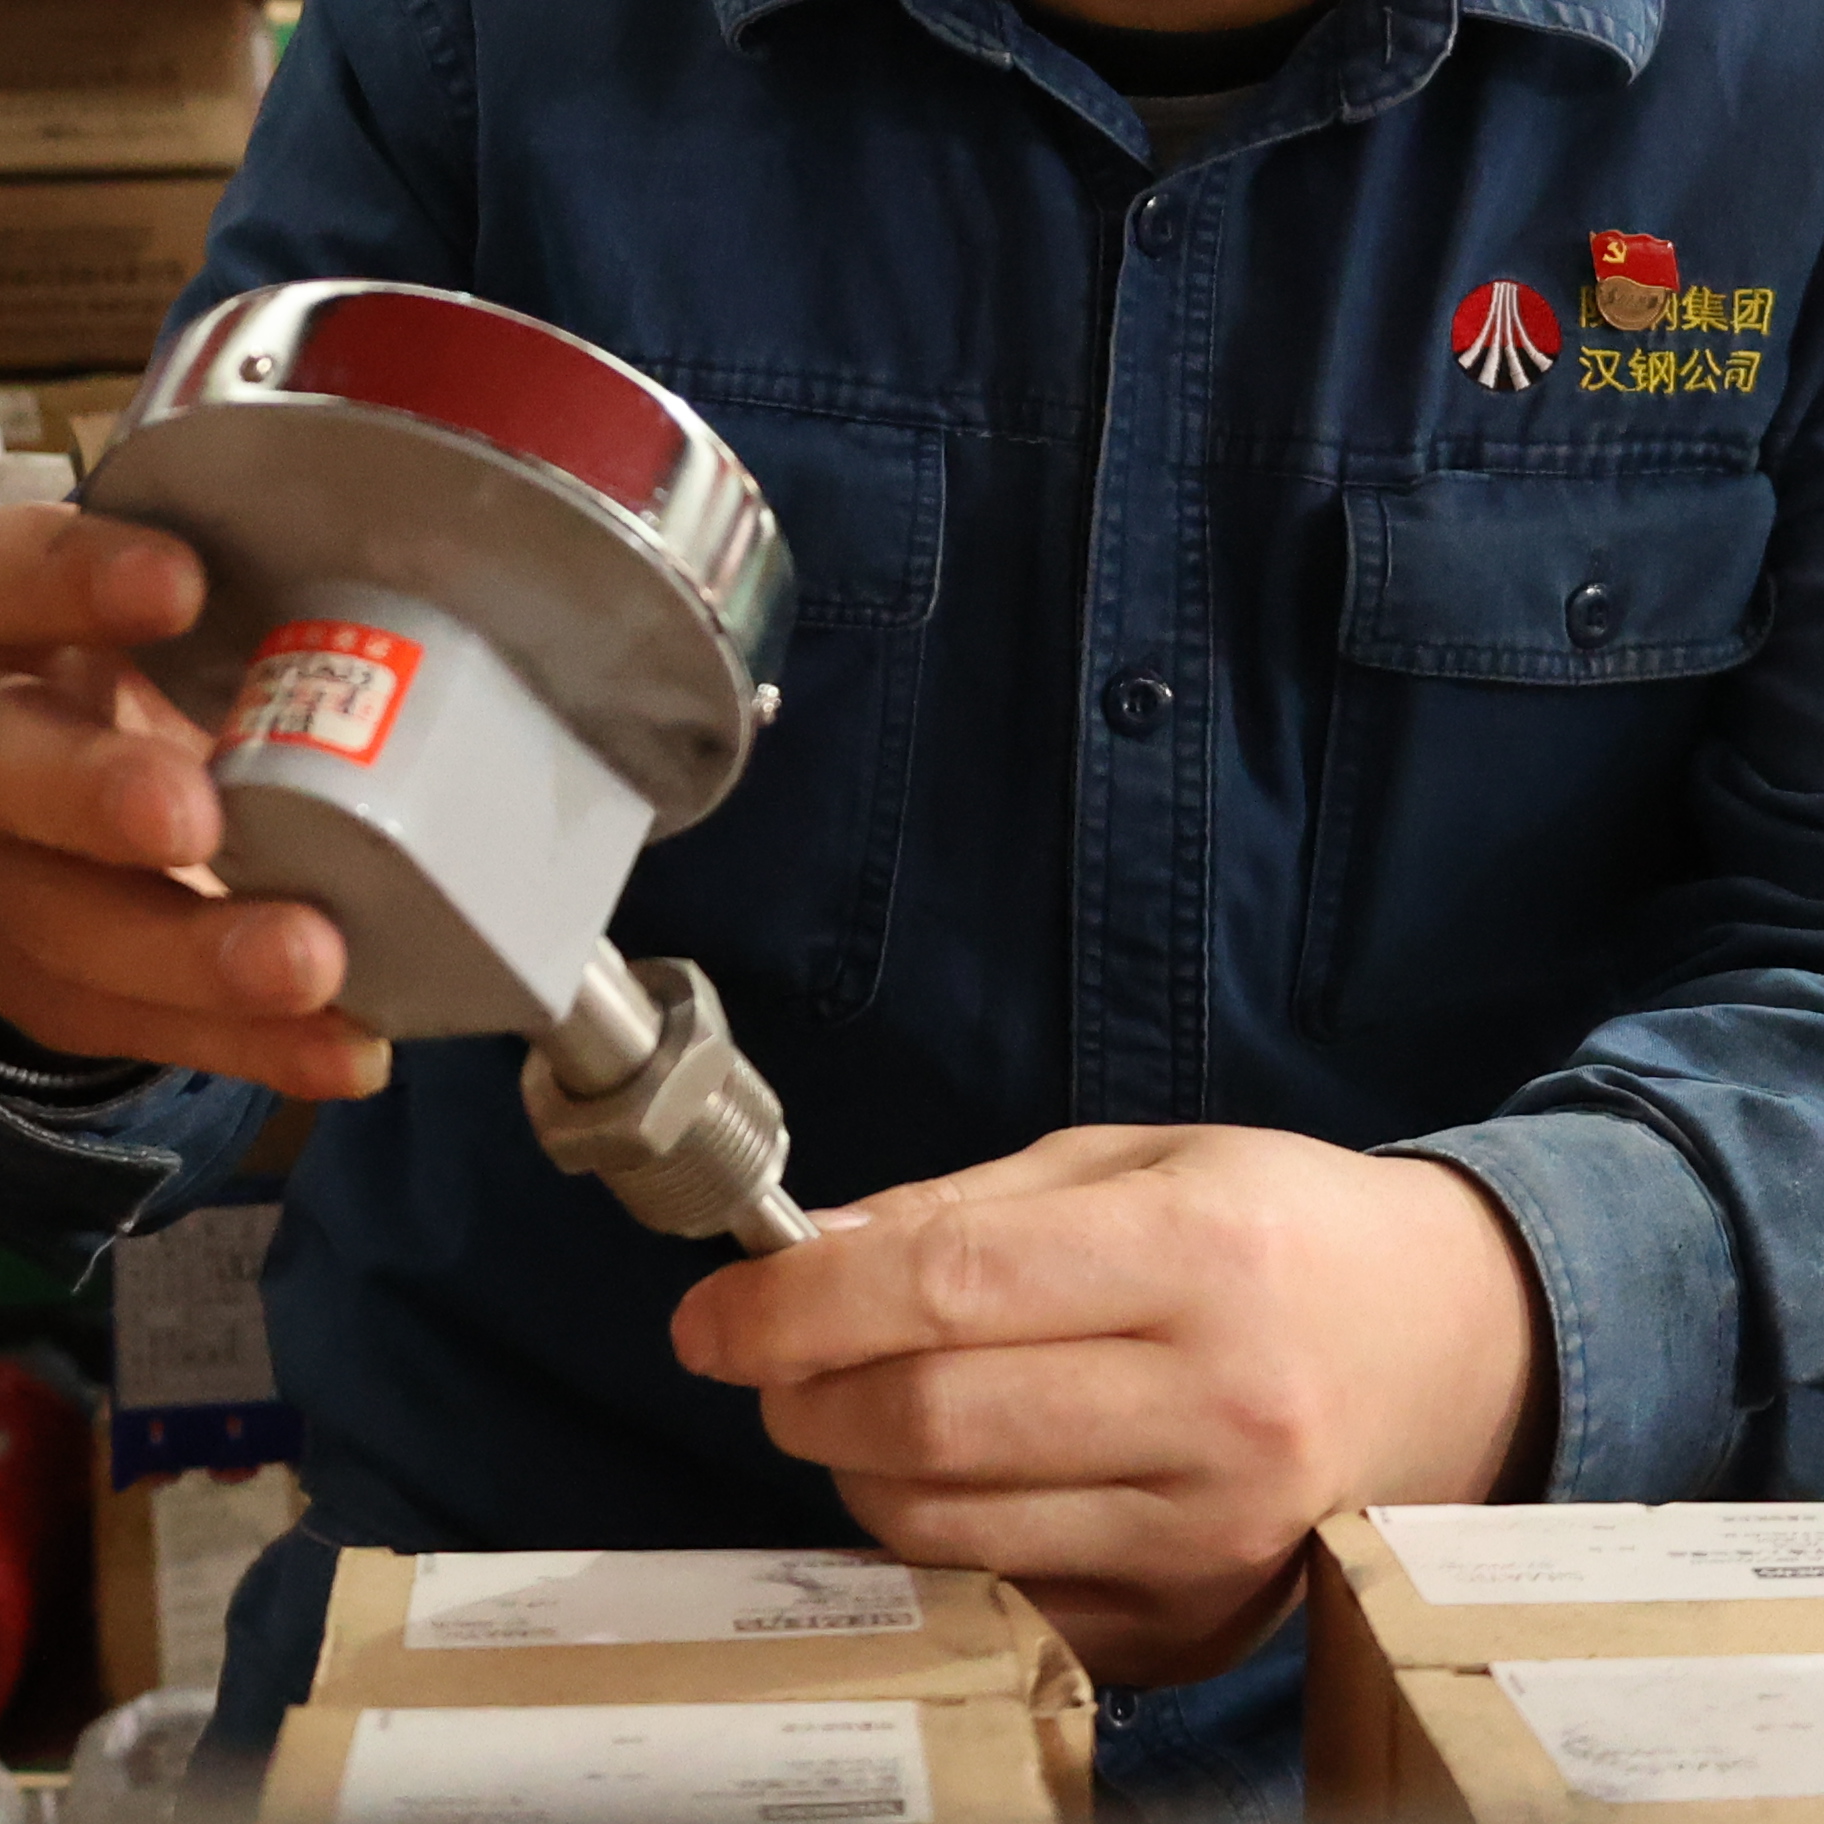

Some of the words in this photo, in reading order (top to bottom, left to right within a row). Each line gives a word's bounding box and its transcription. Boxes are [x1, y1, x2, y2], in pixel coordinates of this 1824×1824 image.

[1578, 284, 1776, 336] 集团
[1578, 346, 1763, 395] 汉钢公司
